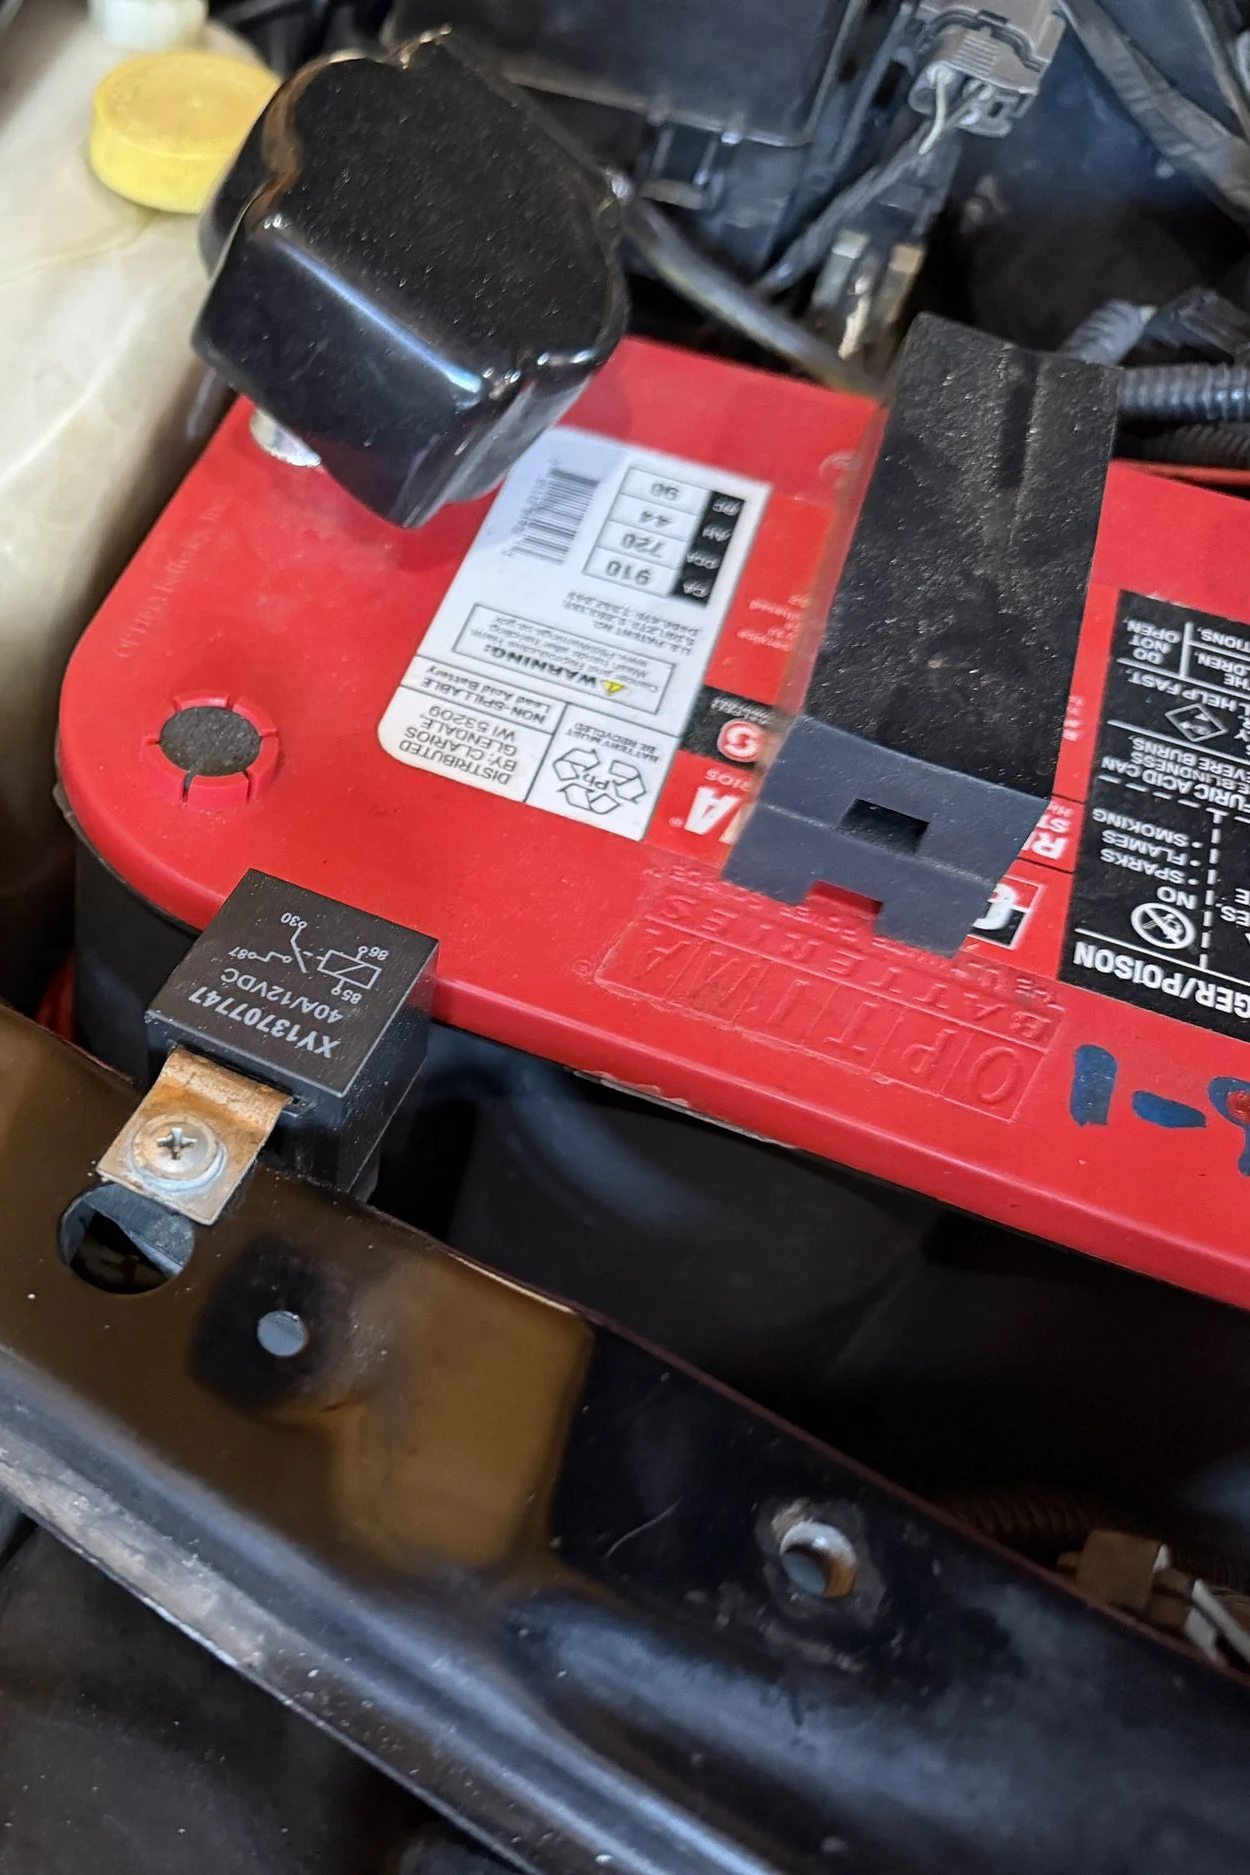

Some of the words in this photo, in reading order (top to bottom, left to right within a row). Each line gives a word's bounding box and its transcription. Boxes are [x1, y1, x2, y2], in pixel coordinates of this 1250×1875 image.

[638, 508, 673, 530] 44
[620, 531, 666, 558] 720
[604, 558, 653, 586] 910
[1128, 632, 1170, 654] NOT
[1131, 646, 1163, 665] DO
[425, 662, 479, 690] Battery
[483, 641, 598, 689] WARNING:
[421, 675, 545, 725] NON-SPILLABLE
[480, 683, 514, 702] Acid
[515, 694, 551, 714] Lead
[1181, 686, 1238, 712] HELP
[428, 703, 490, 734] 53209
[403, 724, 485, 763] CLARIOS
[417, 712, 517, 757] GLENDALE,
[490, 723, 515, 742] WI
[565, 726, 602, 745] MUST
[397, 738, 512, 786] DISTRIBUTED
[602, 737, 659, 762] BATTERY
[1100, 755, 1143, 777] CAN
[1129, 749, 1236, 790] BLINDNESS
[583, 771, 609, 790] Pb
[1141, 767, 1192, 794] ACID
[1089, 807, 1190, 847] SMOKING
[1100, 827, 1187, 866] FLAMES
[1098, 847, 1185, 885] SPARKS
[1155, 884, 1197, 909] NO
[279, 910, 302, 927] 30
[227, 945, 249, 960] 87
[368, 945, 389, 960] 86
[654, 889, 1051, 1041] BATTERIES
[218, 966, 345, 1026] 40A/12VDC
[340, 988, 362, 1004] 85
[187, 985, 341, 1059] XY13707747
[638, 925, 1025, 1112] OPTIMA
